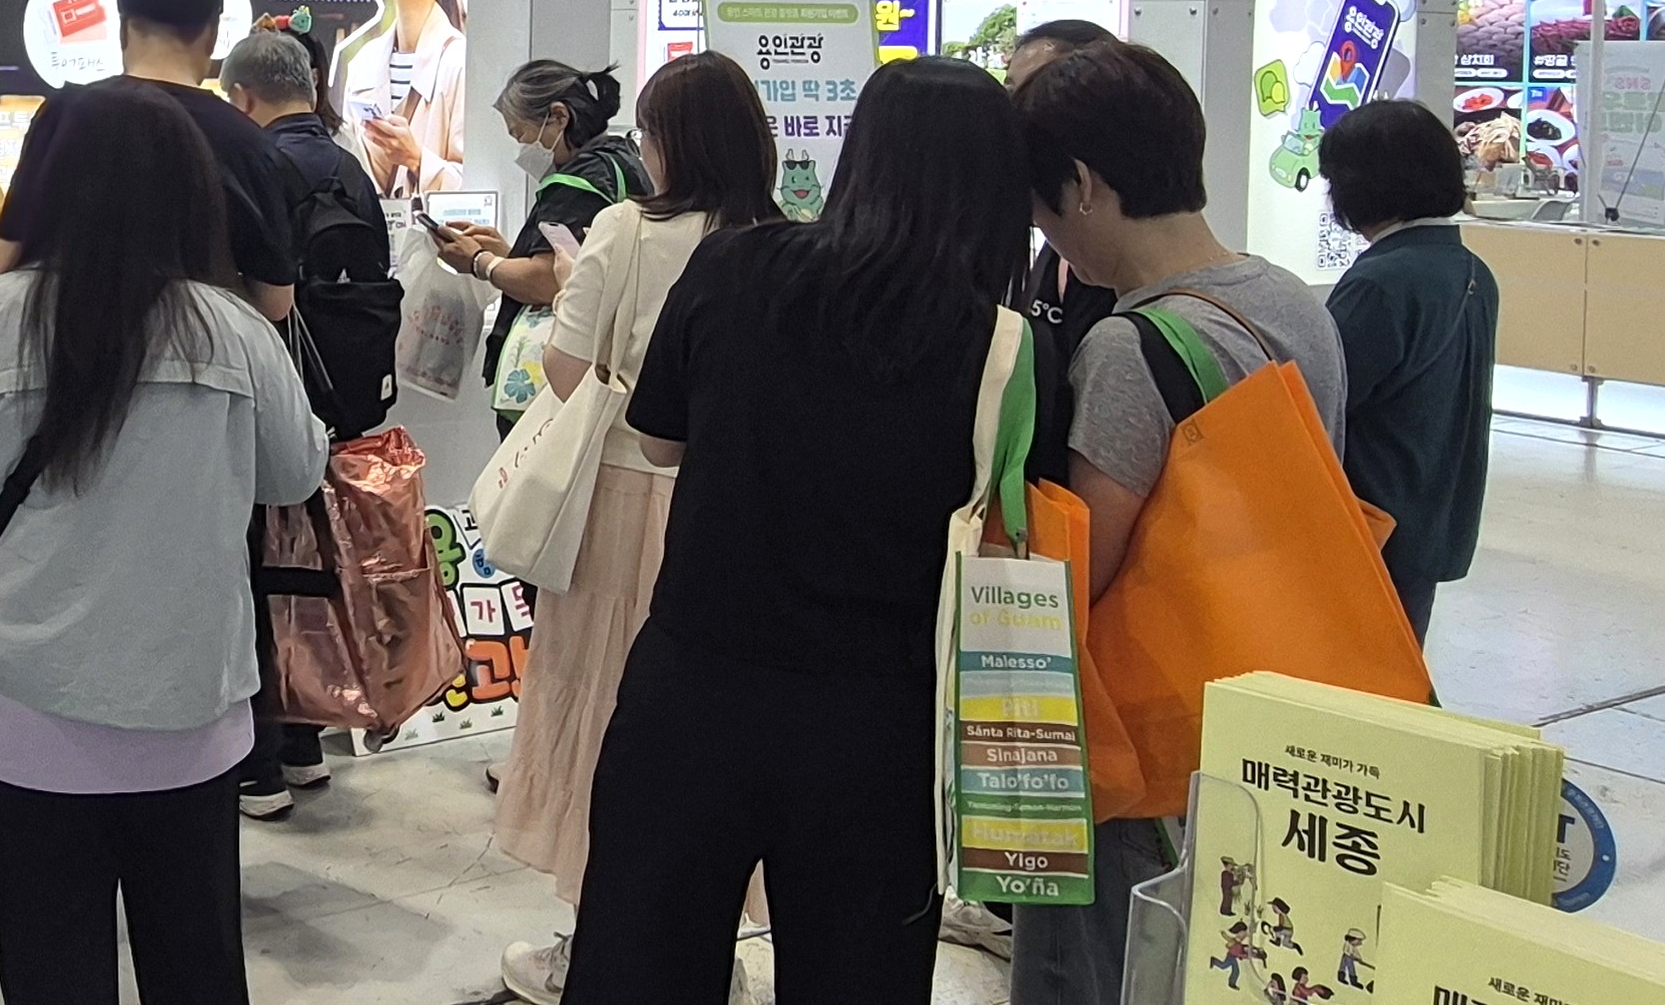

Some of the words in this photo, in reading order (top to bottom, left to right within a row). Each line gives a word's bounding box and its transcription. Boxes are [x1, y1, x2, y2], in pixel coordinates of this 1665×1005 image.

[757, 33, 824, 70] 용인관광
[802, 80, 820, 102] 딱
[826, 78, 857, 101] 3초
[784, 115, 820, 137] 바로
[971, 585, 1059, 610] Villages
[987, 748, 1058, 764] Sinajana
[1285, 745, 1318, 763] 새로운
[1320, 753, 1354, 773] 재미가
[1357, 762, 1381, 780] 가득
[1241, 758, 1426, 835] 매력관광도시
[1281, 808, 1382, 876] 세종
[1004, 852, 1049, 871] Yigo
[1488, 976, 1530, 1002] 새로운
